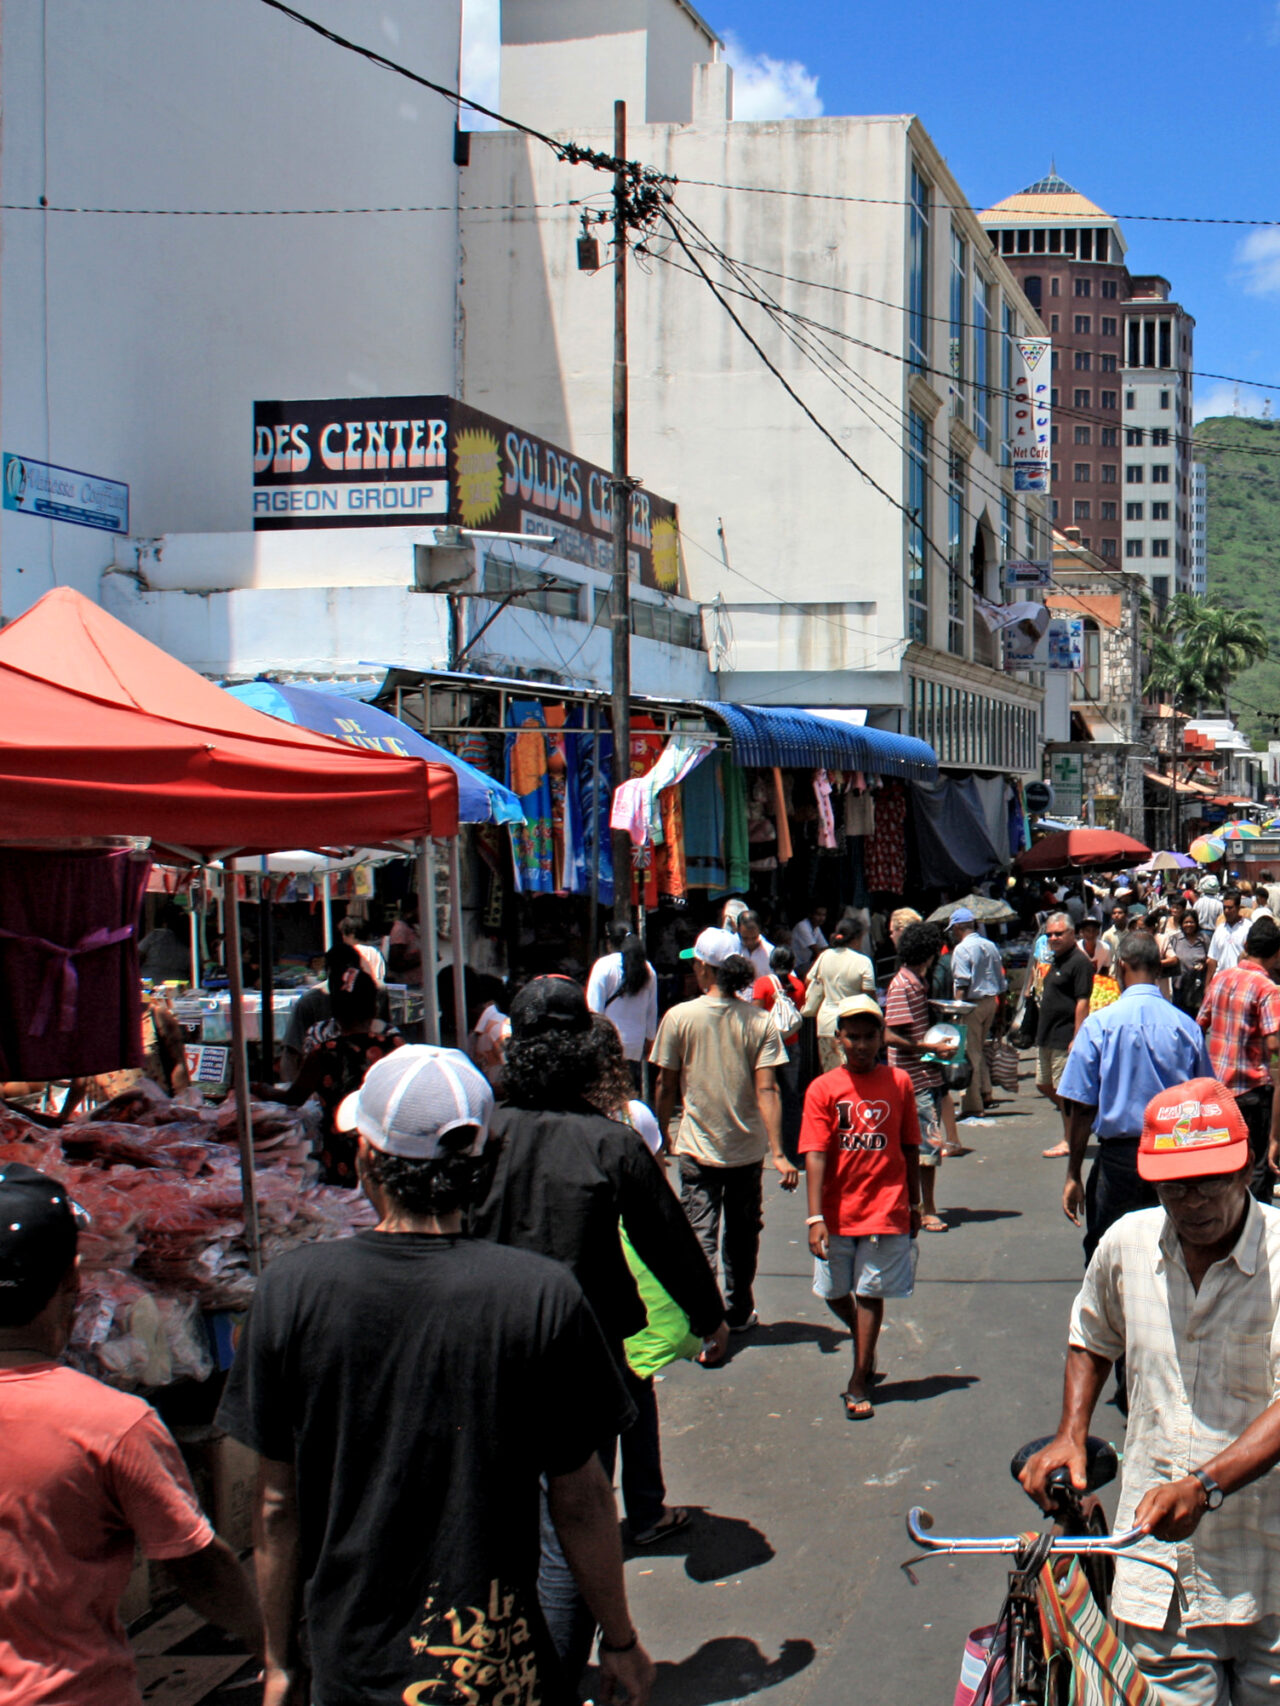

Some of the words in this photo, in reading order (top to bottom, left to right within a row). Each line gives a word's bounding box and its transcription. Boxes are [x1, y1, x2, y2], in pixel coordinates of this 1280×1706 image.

[1015, 376, 1028, 436] POOL
[254, 423, 311, 473] DES
[320, 419, 447, 471] CENTER
[1013, 447, 1027, 458] Net
[1030, 445, 1049, 460] Café
[253, 489, 339, 512] RGEON
[348, 487, 434, 510] GROUP
[505, 432, 582, 520] SOLDES
[589, 471, 651, 549] CEER
[836, 1100, 855, 1131] I
[838, 1132, 888, 1151] RND
